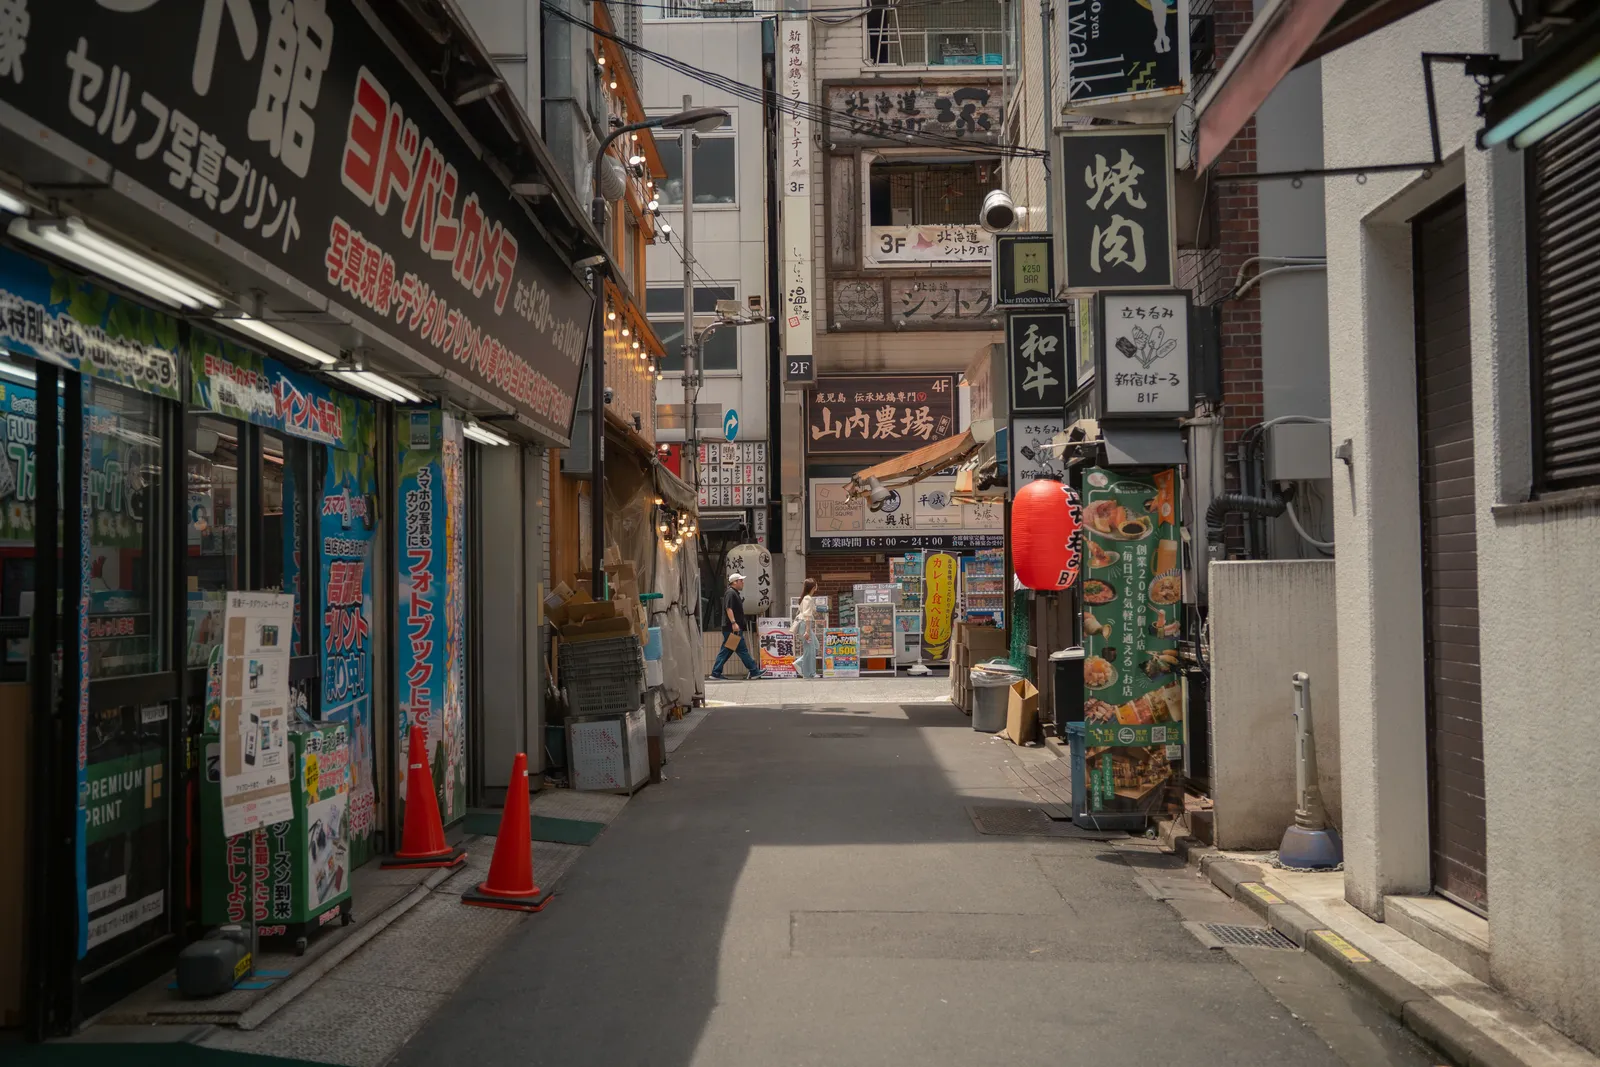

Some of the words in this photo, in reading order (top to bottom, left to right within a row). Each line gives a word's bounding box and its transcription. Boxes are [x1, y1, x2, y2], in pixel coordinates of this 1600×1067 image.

[1145, 79, 1157, 90] 2F
[845, 91, 921, 115] 北海道
[66, 36, 301, 254] セルフ写真プリント
[341, 65, 518, 316] ヨドバシカメラ
[790, 182, 806, 192] 3F
[1083, 148, 1150, 275] 焼肉
[880, 234, 907, 254] 3F
[937, 230, 981, 244] 北海道
[944, 245, 990, 256] シントク町
[1022, 265, 1041, 273] ¥250
[1024, 275, 1039, 284] BAR
[1121, 306, 1174, 319] 立ち呑み
[790, 361, 811, 374] 2F
[1020, 324, 1059, 400] 和牛
[932, 380, 949, 393] 4F
[1115, 372, 1180, 387] 新宿ばーる
[271, 371, 344, 441] ポイント還元!
[815, 392, 847, 404] 鹿児島
[854, 392, 917, 403] 伝承地鶏専門
[1137, 393, 1160, 403] B1F
[812, 405, 936, 441] 山内農場
[1024, 425, 1061, 435] 立ち呑み
[416, 466, 432, 548] スマホの写真も
[918, 493, 960, 508] 平成
[404, 490, 420, 548] カンタンに
[821, 537, 862, 547] 営業時間
[866, 537, 897, 547] 16:00
[911, 537, 943, 547] 24:00
[930, 557, 944, 641] カレー食べ放題
[1136, 544, 1148, 651] 創業20年の個人店
[325, 606, 368, 653] プリント
[1122, 545, 1135, 698] 「毎日でも気軽に通える」お店
[760, 635, 794, 656] 半額
[85, 768, 143, 802] PREMIUM
[85, 799, 122, 828] PRINT
[273, 820, 292, 919] シーズン到来
